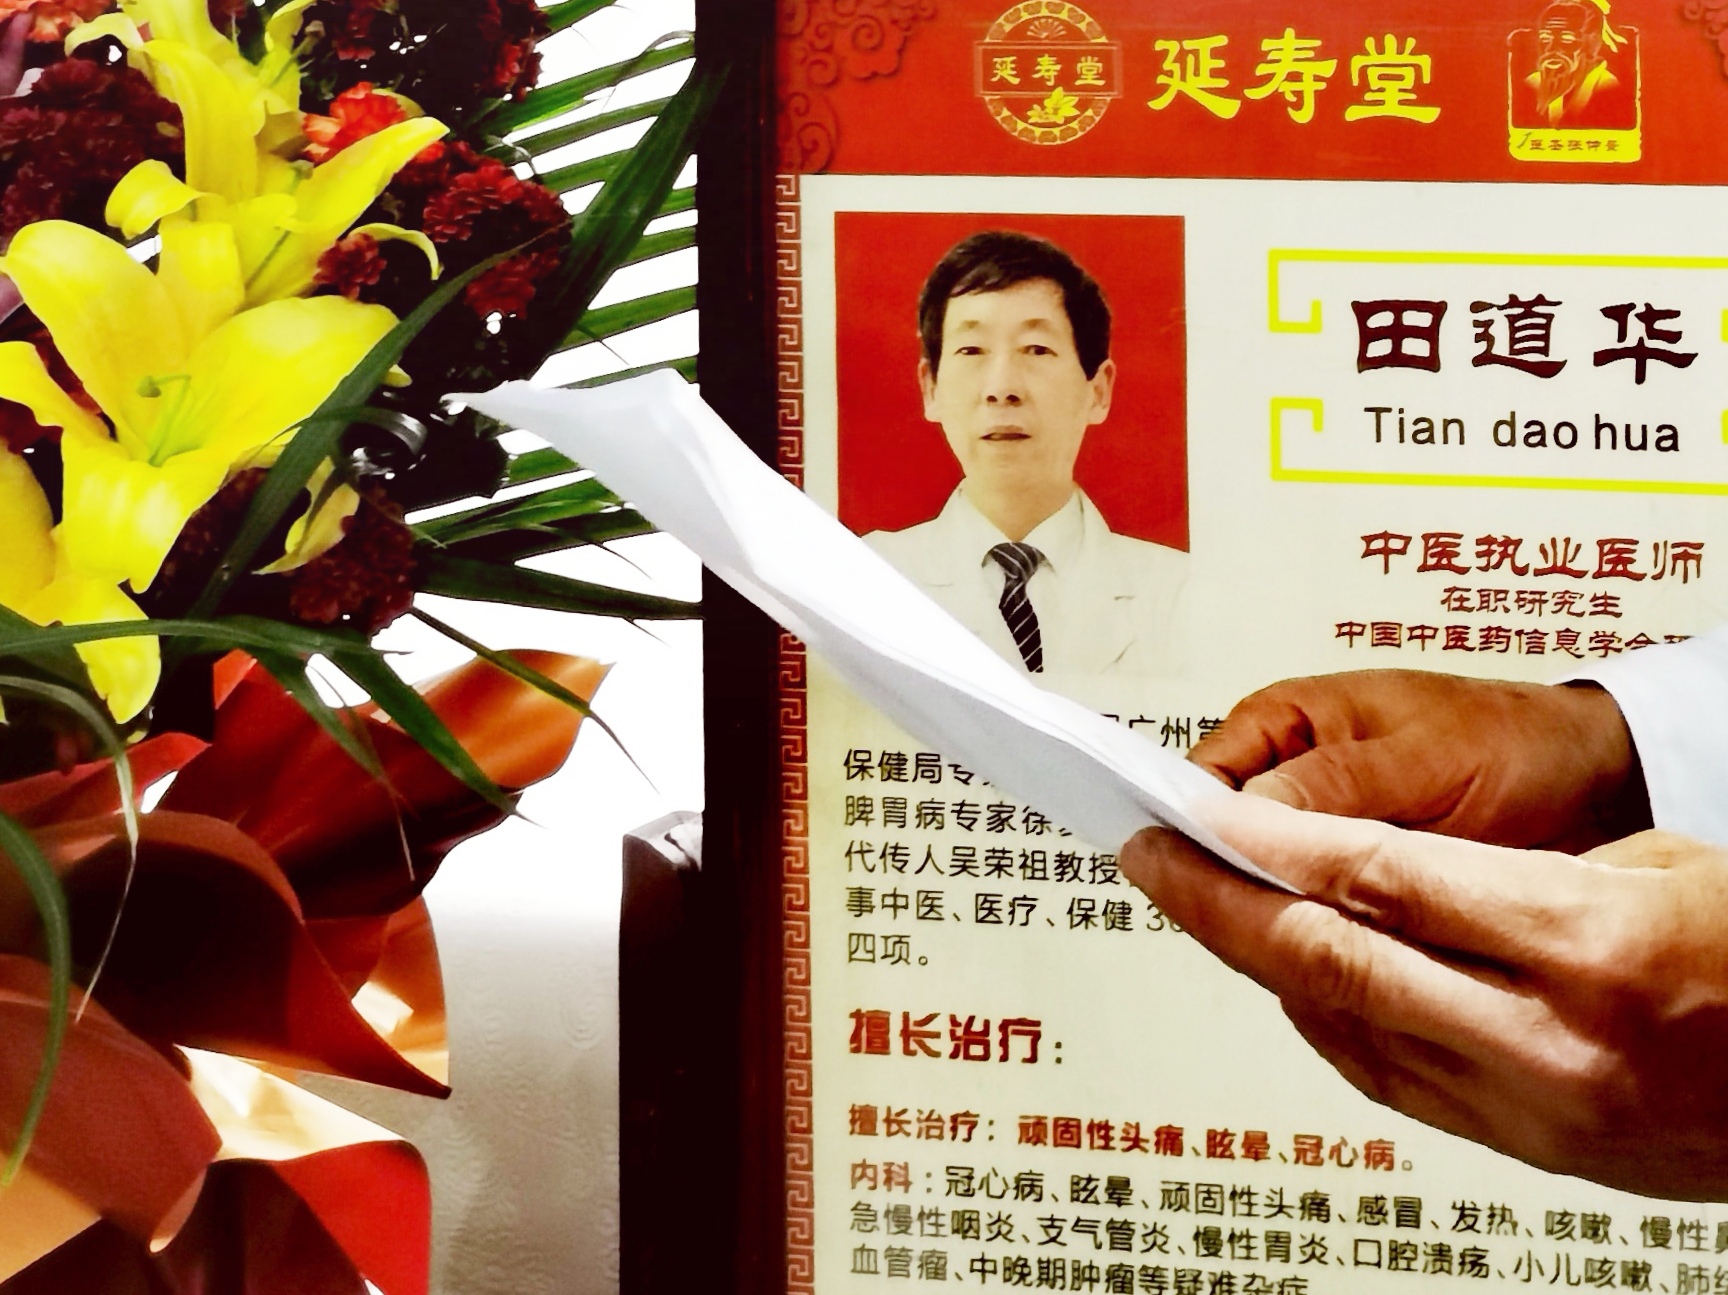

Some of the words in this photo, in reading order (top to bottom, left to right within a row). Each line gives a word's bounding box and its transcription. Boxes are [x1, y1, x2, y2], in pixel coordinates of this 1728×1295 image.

[990, 54, 1106, 86] 延寿堂
[1147, 27, 1442, 124] 延寿堂
[1351, 294, 1699, 385] 田道华
[1364, 406, 1465, 445] Tian
[1360, 530, 1705, 583] 中医执业医师
[1440, 586, 1623, 620] 在职研究生
[843, 748, 996, 787] 保健局专
[843, 795, 1073, 836] 脾胃病专家徐
[847, 931, 930, 967] 四项。
